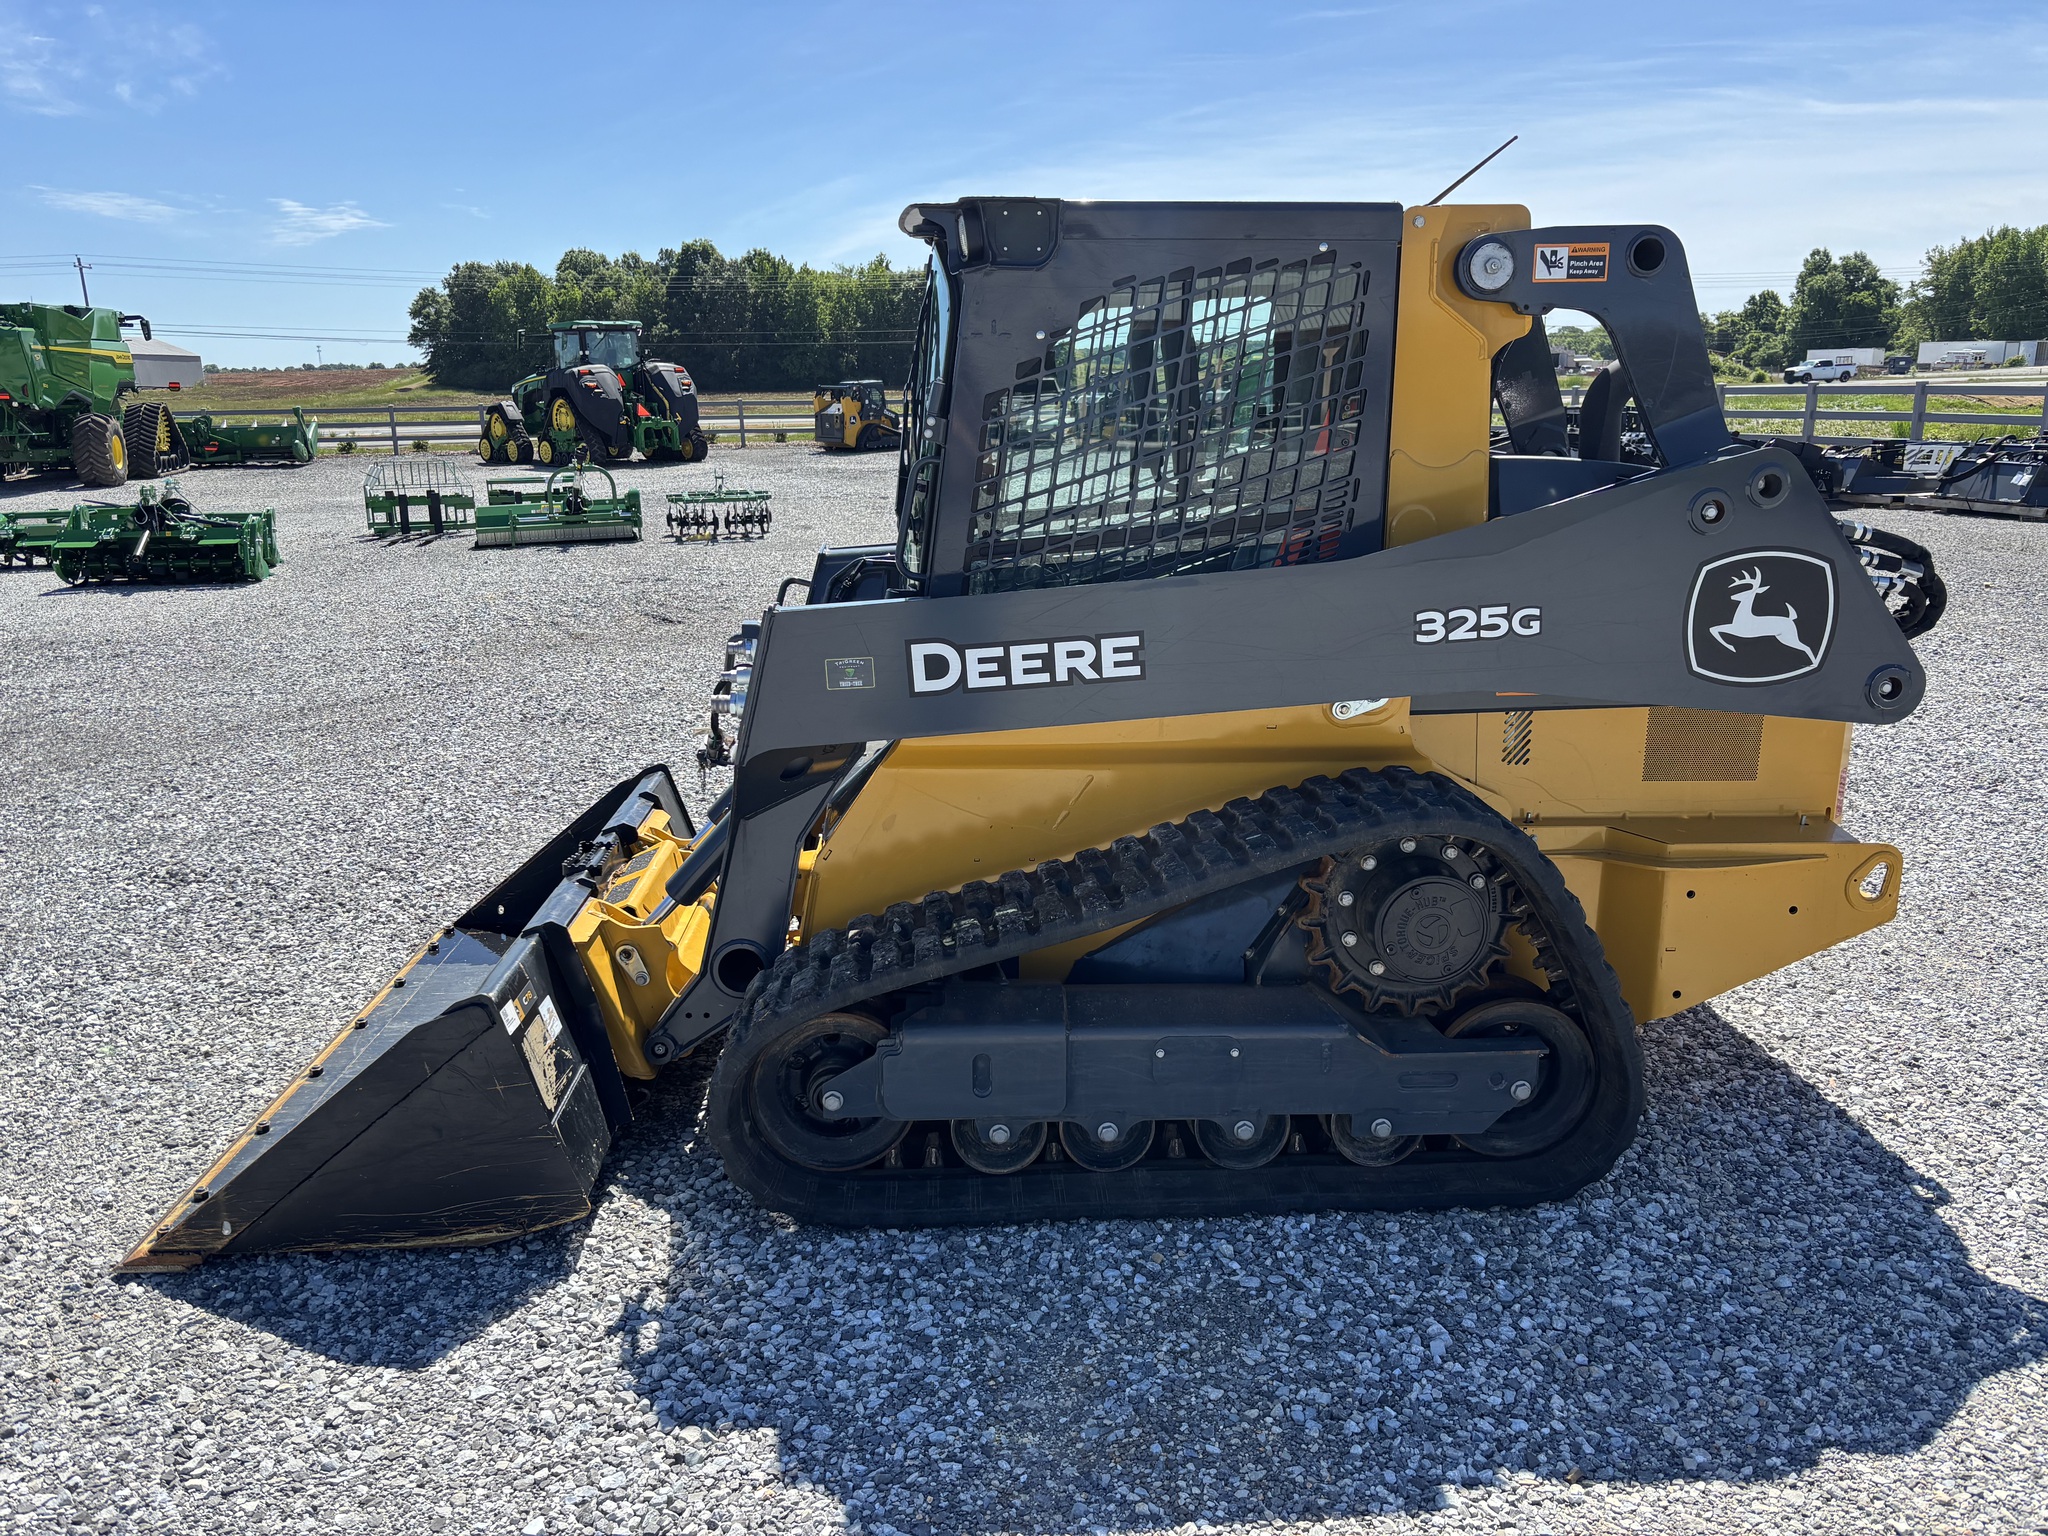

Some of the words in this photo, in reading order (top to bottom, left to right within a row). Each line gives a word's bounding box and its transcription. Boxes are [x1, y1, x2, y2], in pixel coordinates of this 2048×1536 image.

[1416, 606, 1541, 643] 325G
[910, 636, 1141, 693] DEERE
[1406, 945, 1459, 966] SPICER
